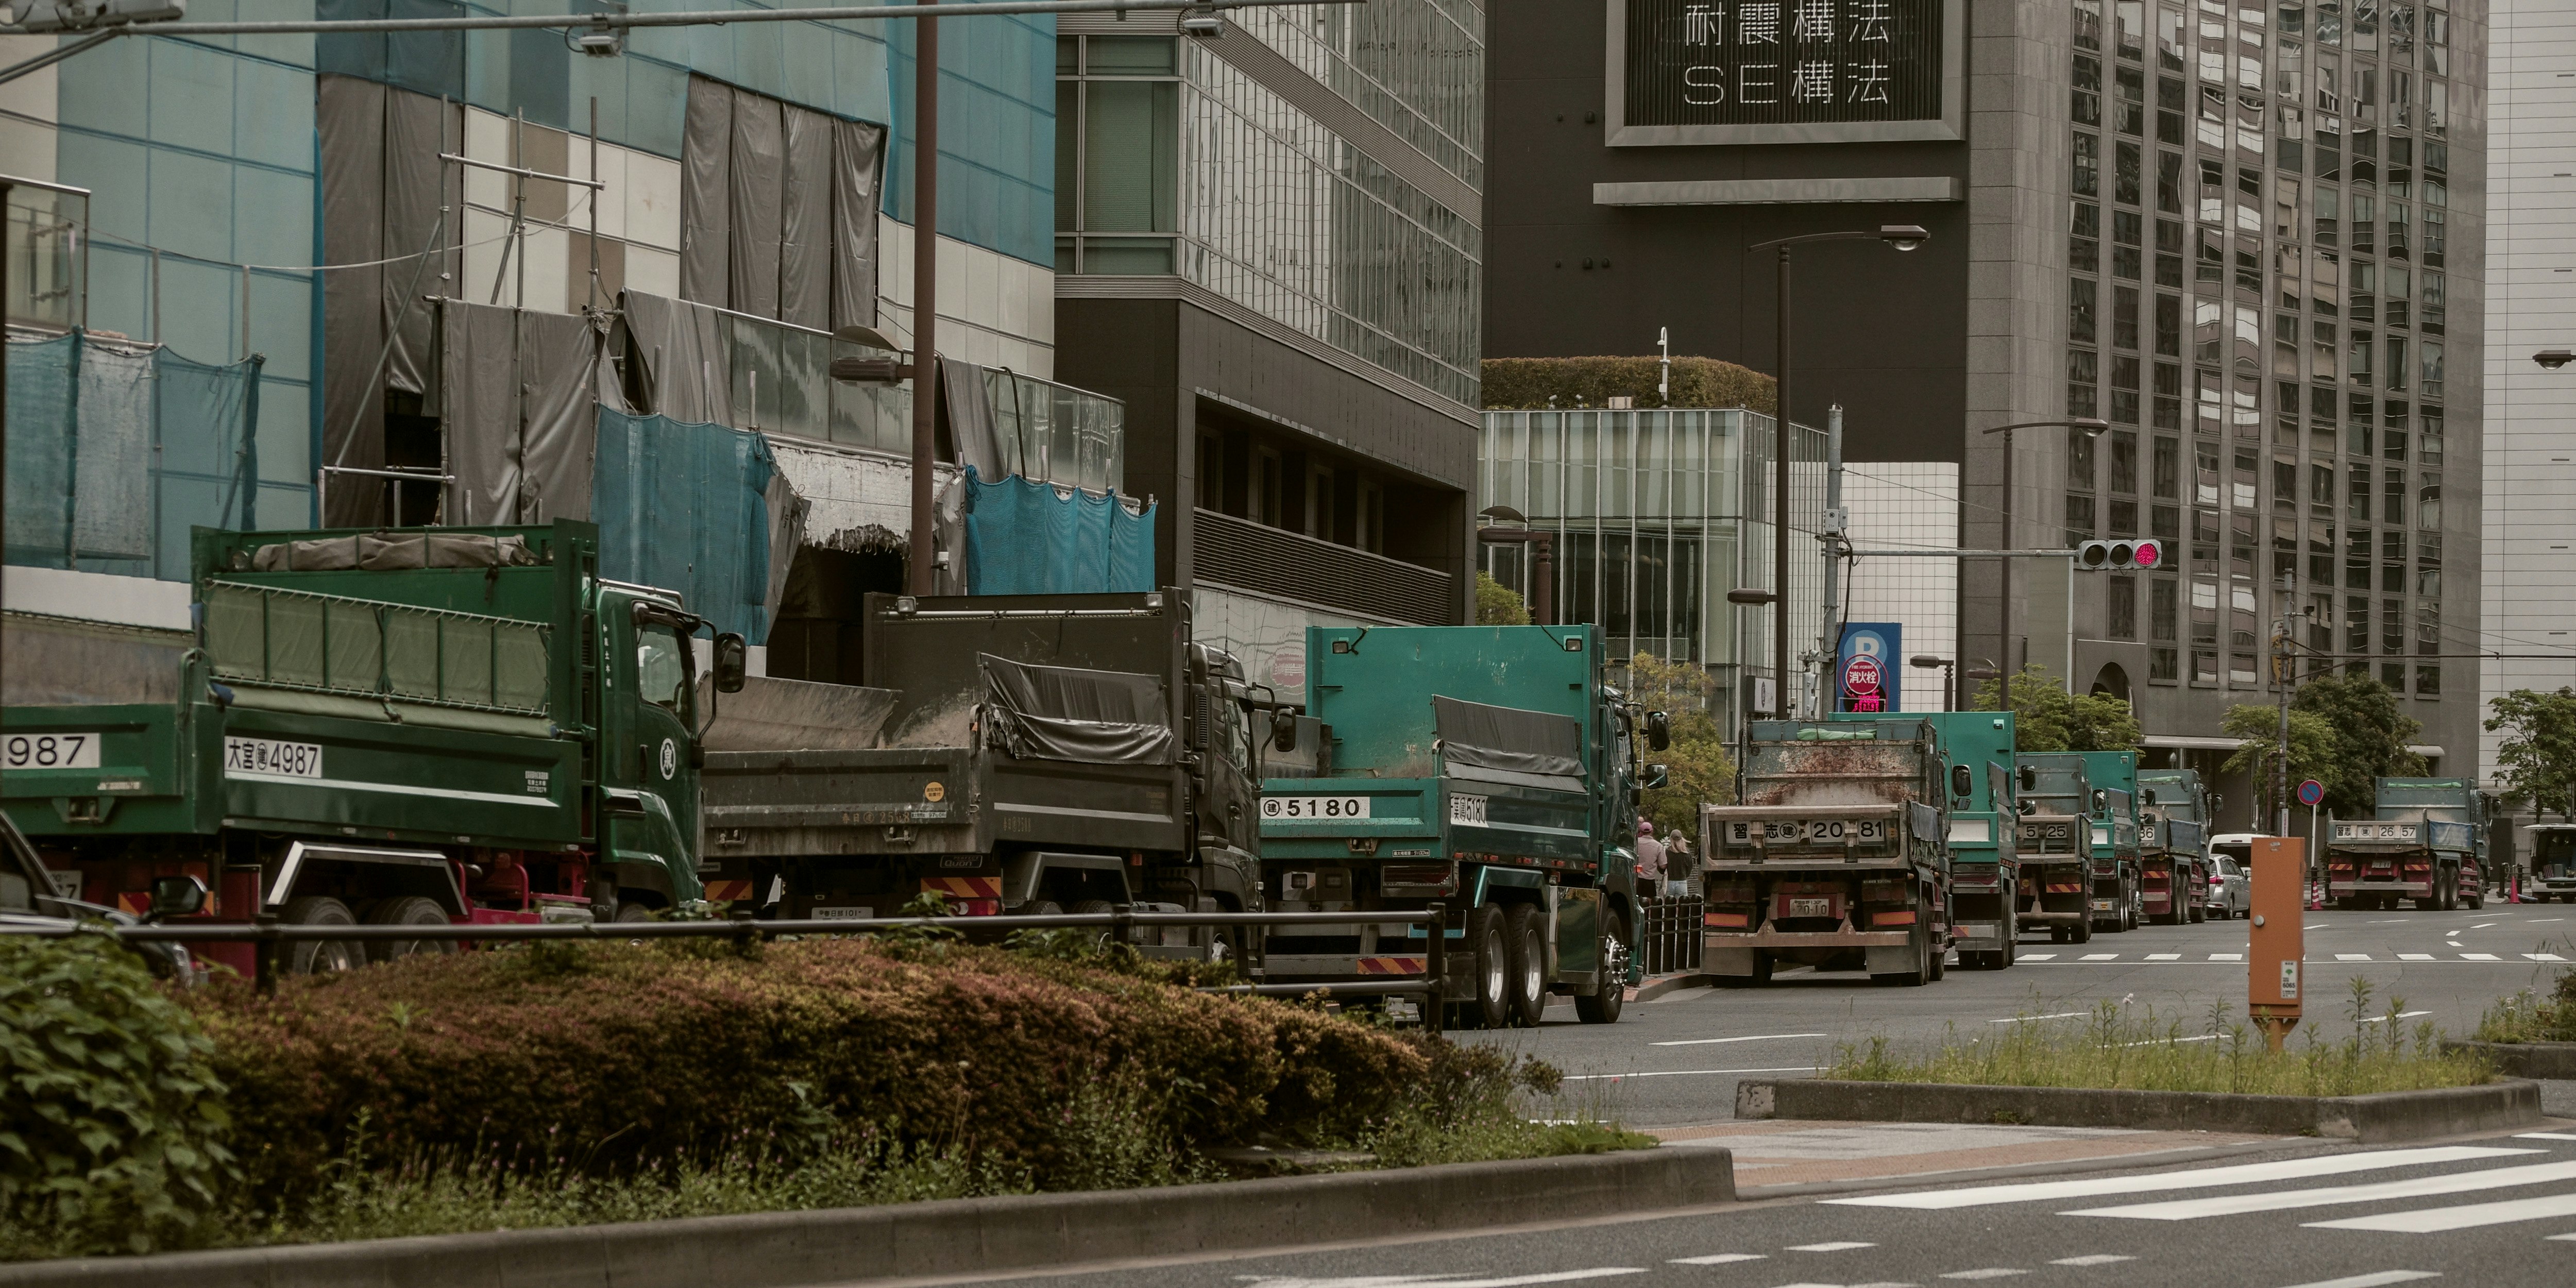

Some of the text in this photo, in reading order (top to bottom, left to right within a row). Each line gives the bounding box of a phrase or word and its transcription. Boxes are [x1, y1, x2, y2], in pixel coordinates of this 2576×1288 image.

[1686, 0, 1890, 46] 耐震構法
[1685, 59, 1890, 104] SE構法
[1855, 637, 1879, 661] P
[1849, 671, 1877, 684] 消火栓
[0, 737, 85, 766] 987
[2047, 826, 2065, 837] 25
